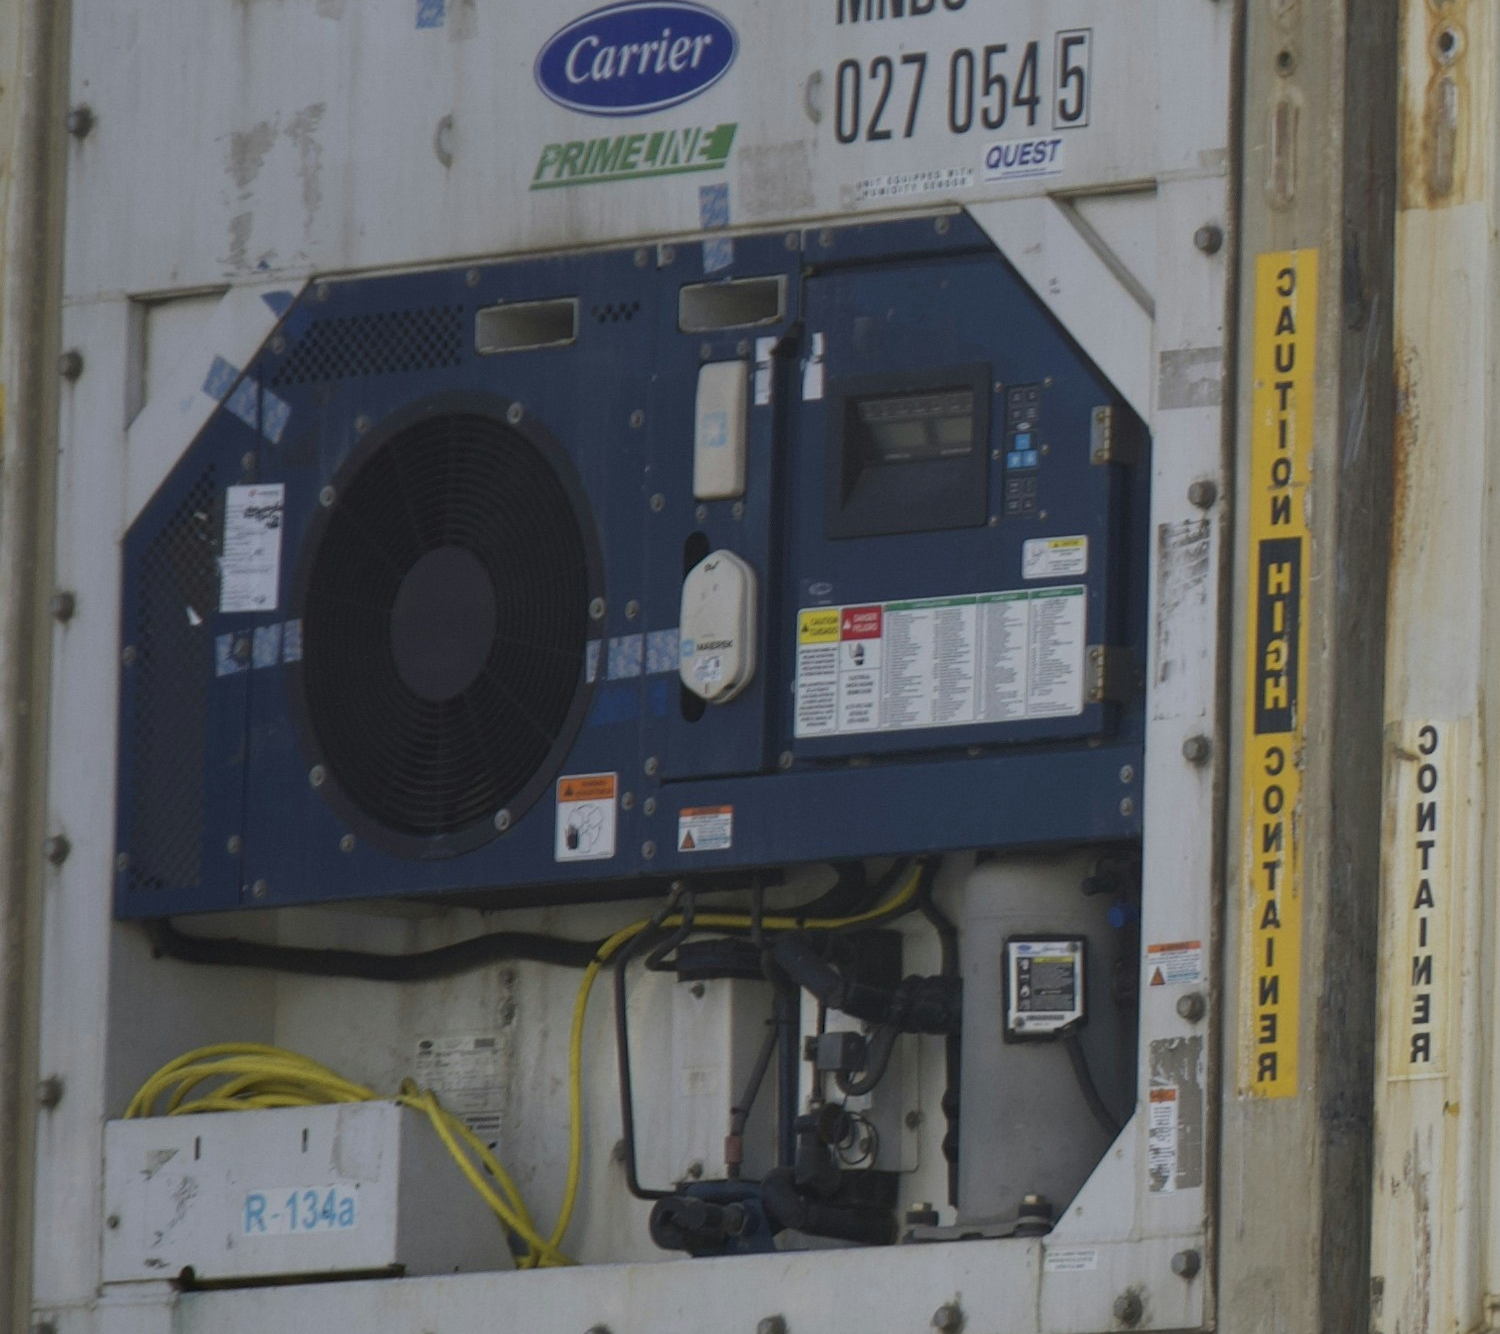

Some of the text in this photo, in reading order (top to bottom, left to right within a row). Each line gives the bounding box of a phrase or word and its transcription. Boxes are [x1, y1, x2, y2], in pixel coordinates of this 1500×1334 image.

[562, 26, 714, 87] Carrier
[834, 33, 1086, 145] 027 054 5
[985, 139, 1062, 169] QUEST
[244, 1188, 355, 1235] R-134a
